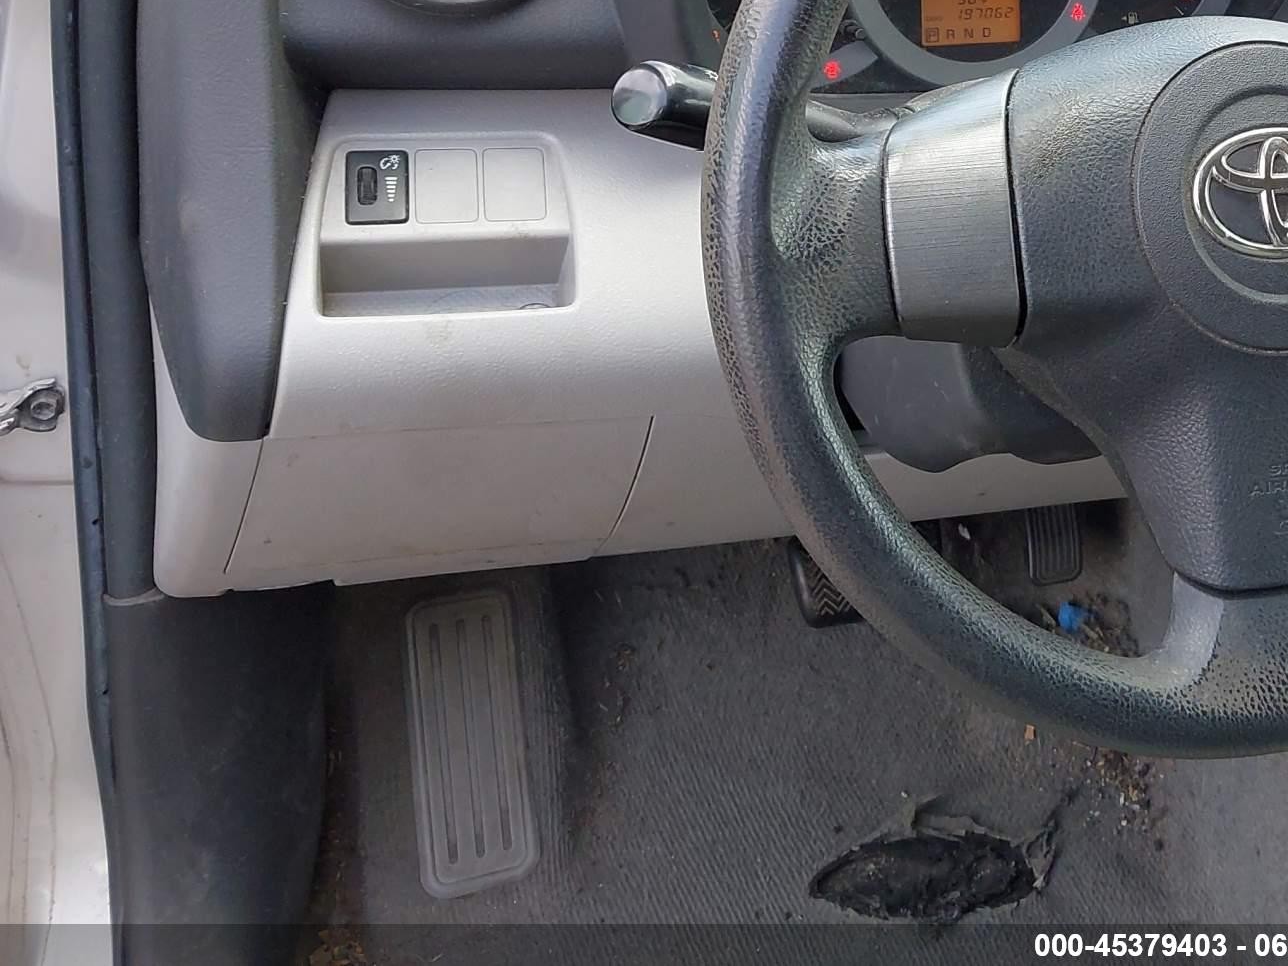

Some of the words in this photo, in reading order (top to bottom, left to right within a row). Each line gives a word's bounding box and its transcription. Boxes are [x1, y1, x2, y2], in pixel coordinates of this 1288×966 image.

[957, 6, 1014, 20] 197062
[963, 27, 974, 39] N
[982, 27, 992, 38] D
